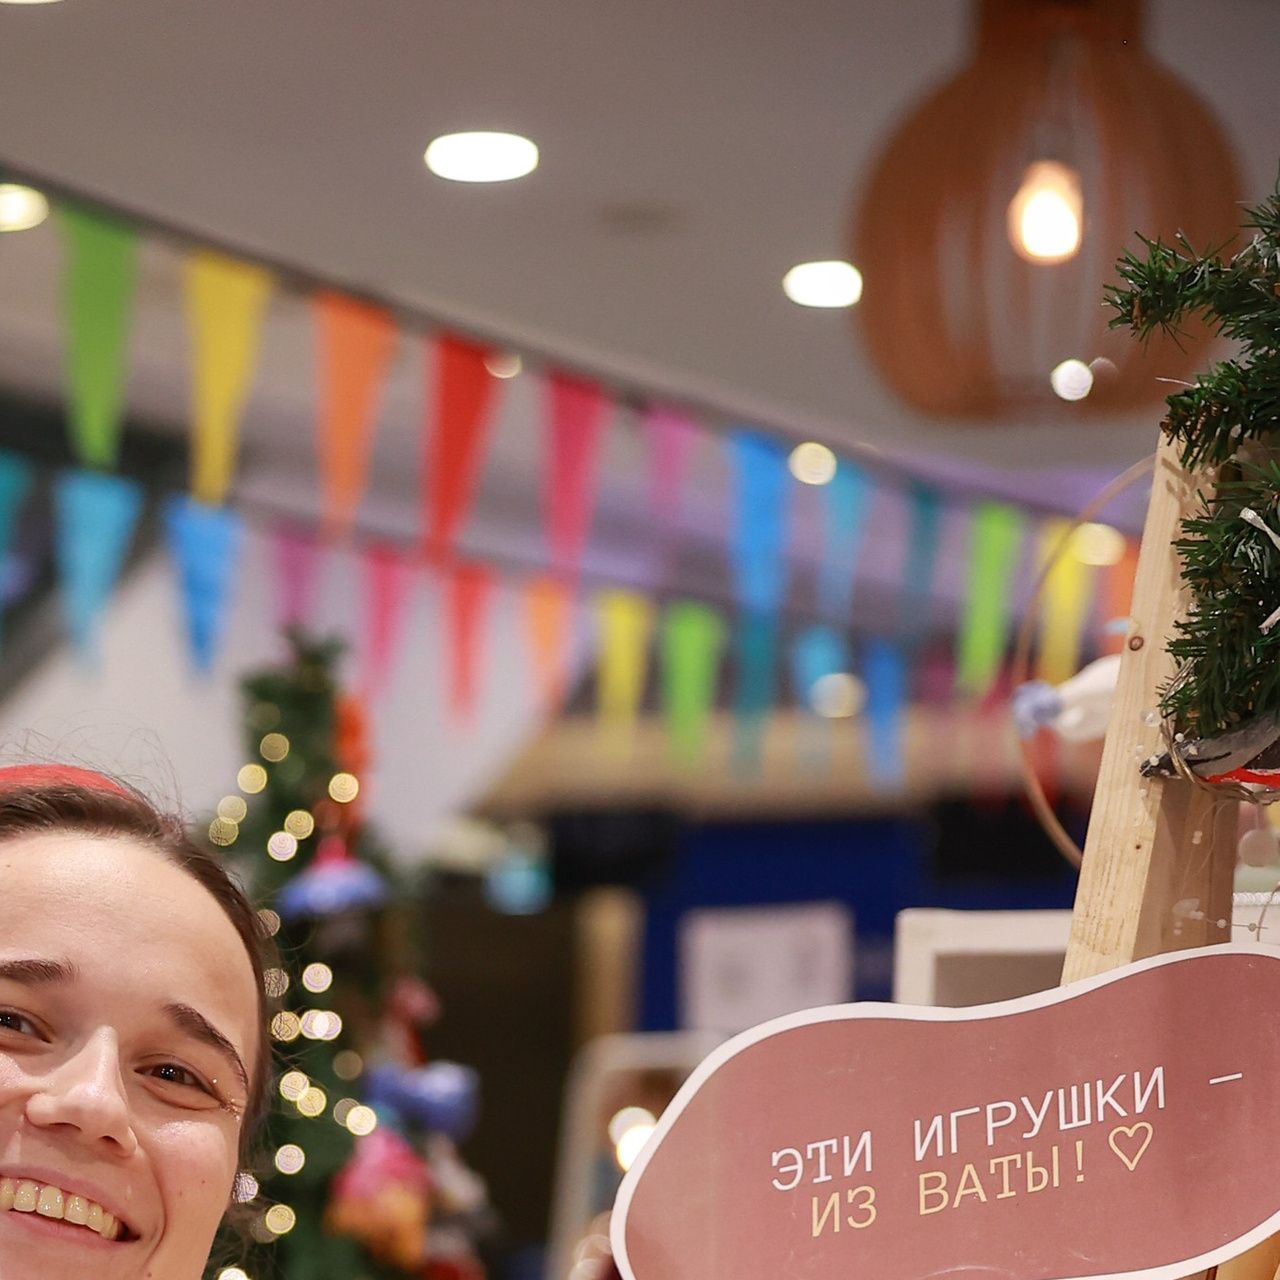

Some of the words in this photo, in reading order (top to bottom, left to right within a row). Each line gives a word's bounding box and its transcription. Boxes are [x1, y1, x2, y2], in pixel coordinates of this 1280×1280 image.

[771, 1130, 872, 1191] ЭТИ
[913, 1066, 1167, 1162] ИГРУШКИ
[811, 1185, 877, 1238] ИЗ
[918, 1139, 1084, 1216] ВАТЫ!
